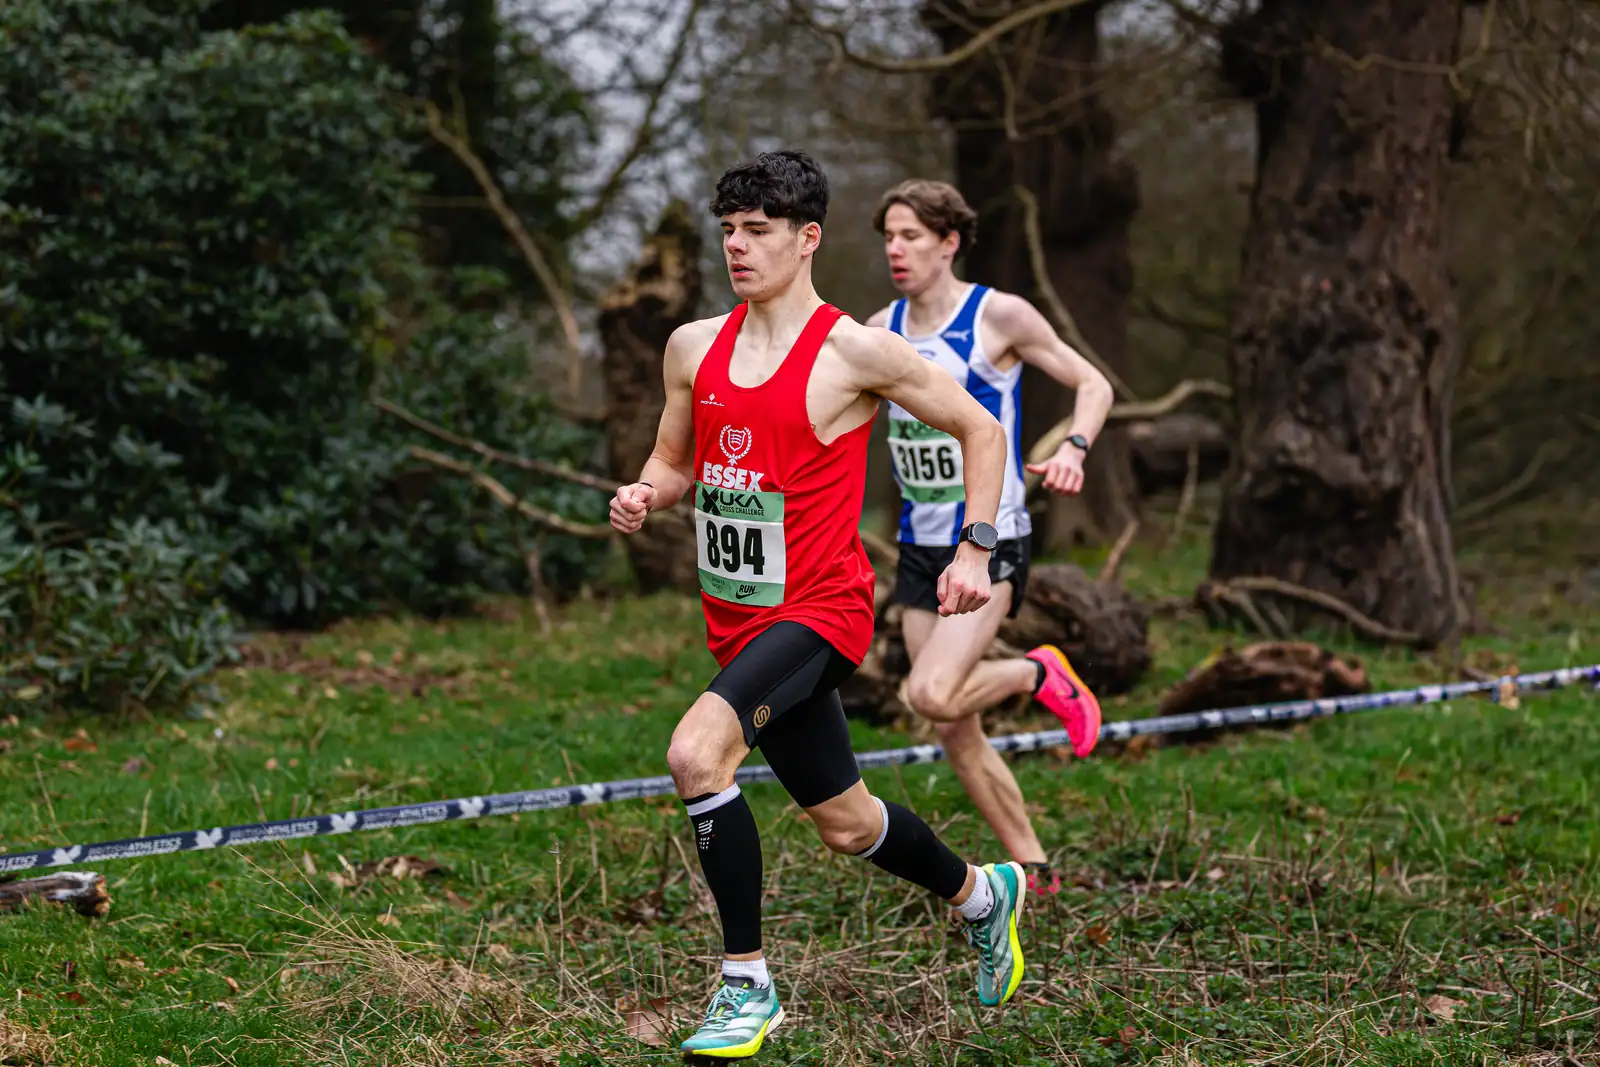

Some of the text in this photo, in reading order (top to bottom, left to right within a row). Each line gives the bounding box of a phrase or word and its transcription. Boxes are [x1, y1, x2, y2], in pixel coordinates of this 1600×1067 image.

[703, 461, 764, 492] ESSEX
[897, 445, 956, 481] 3156
[720, 504, 765, 516] CROSS CHALLENGE
[706, 520, 765, 576] 894
[739, 584, 756, 594] RUN
